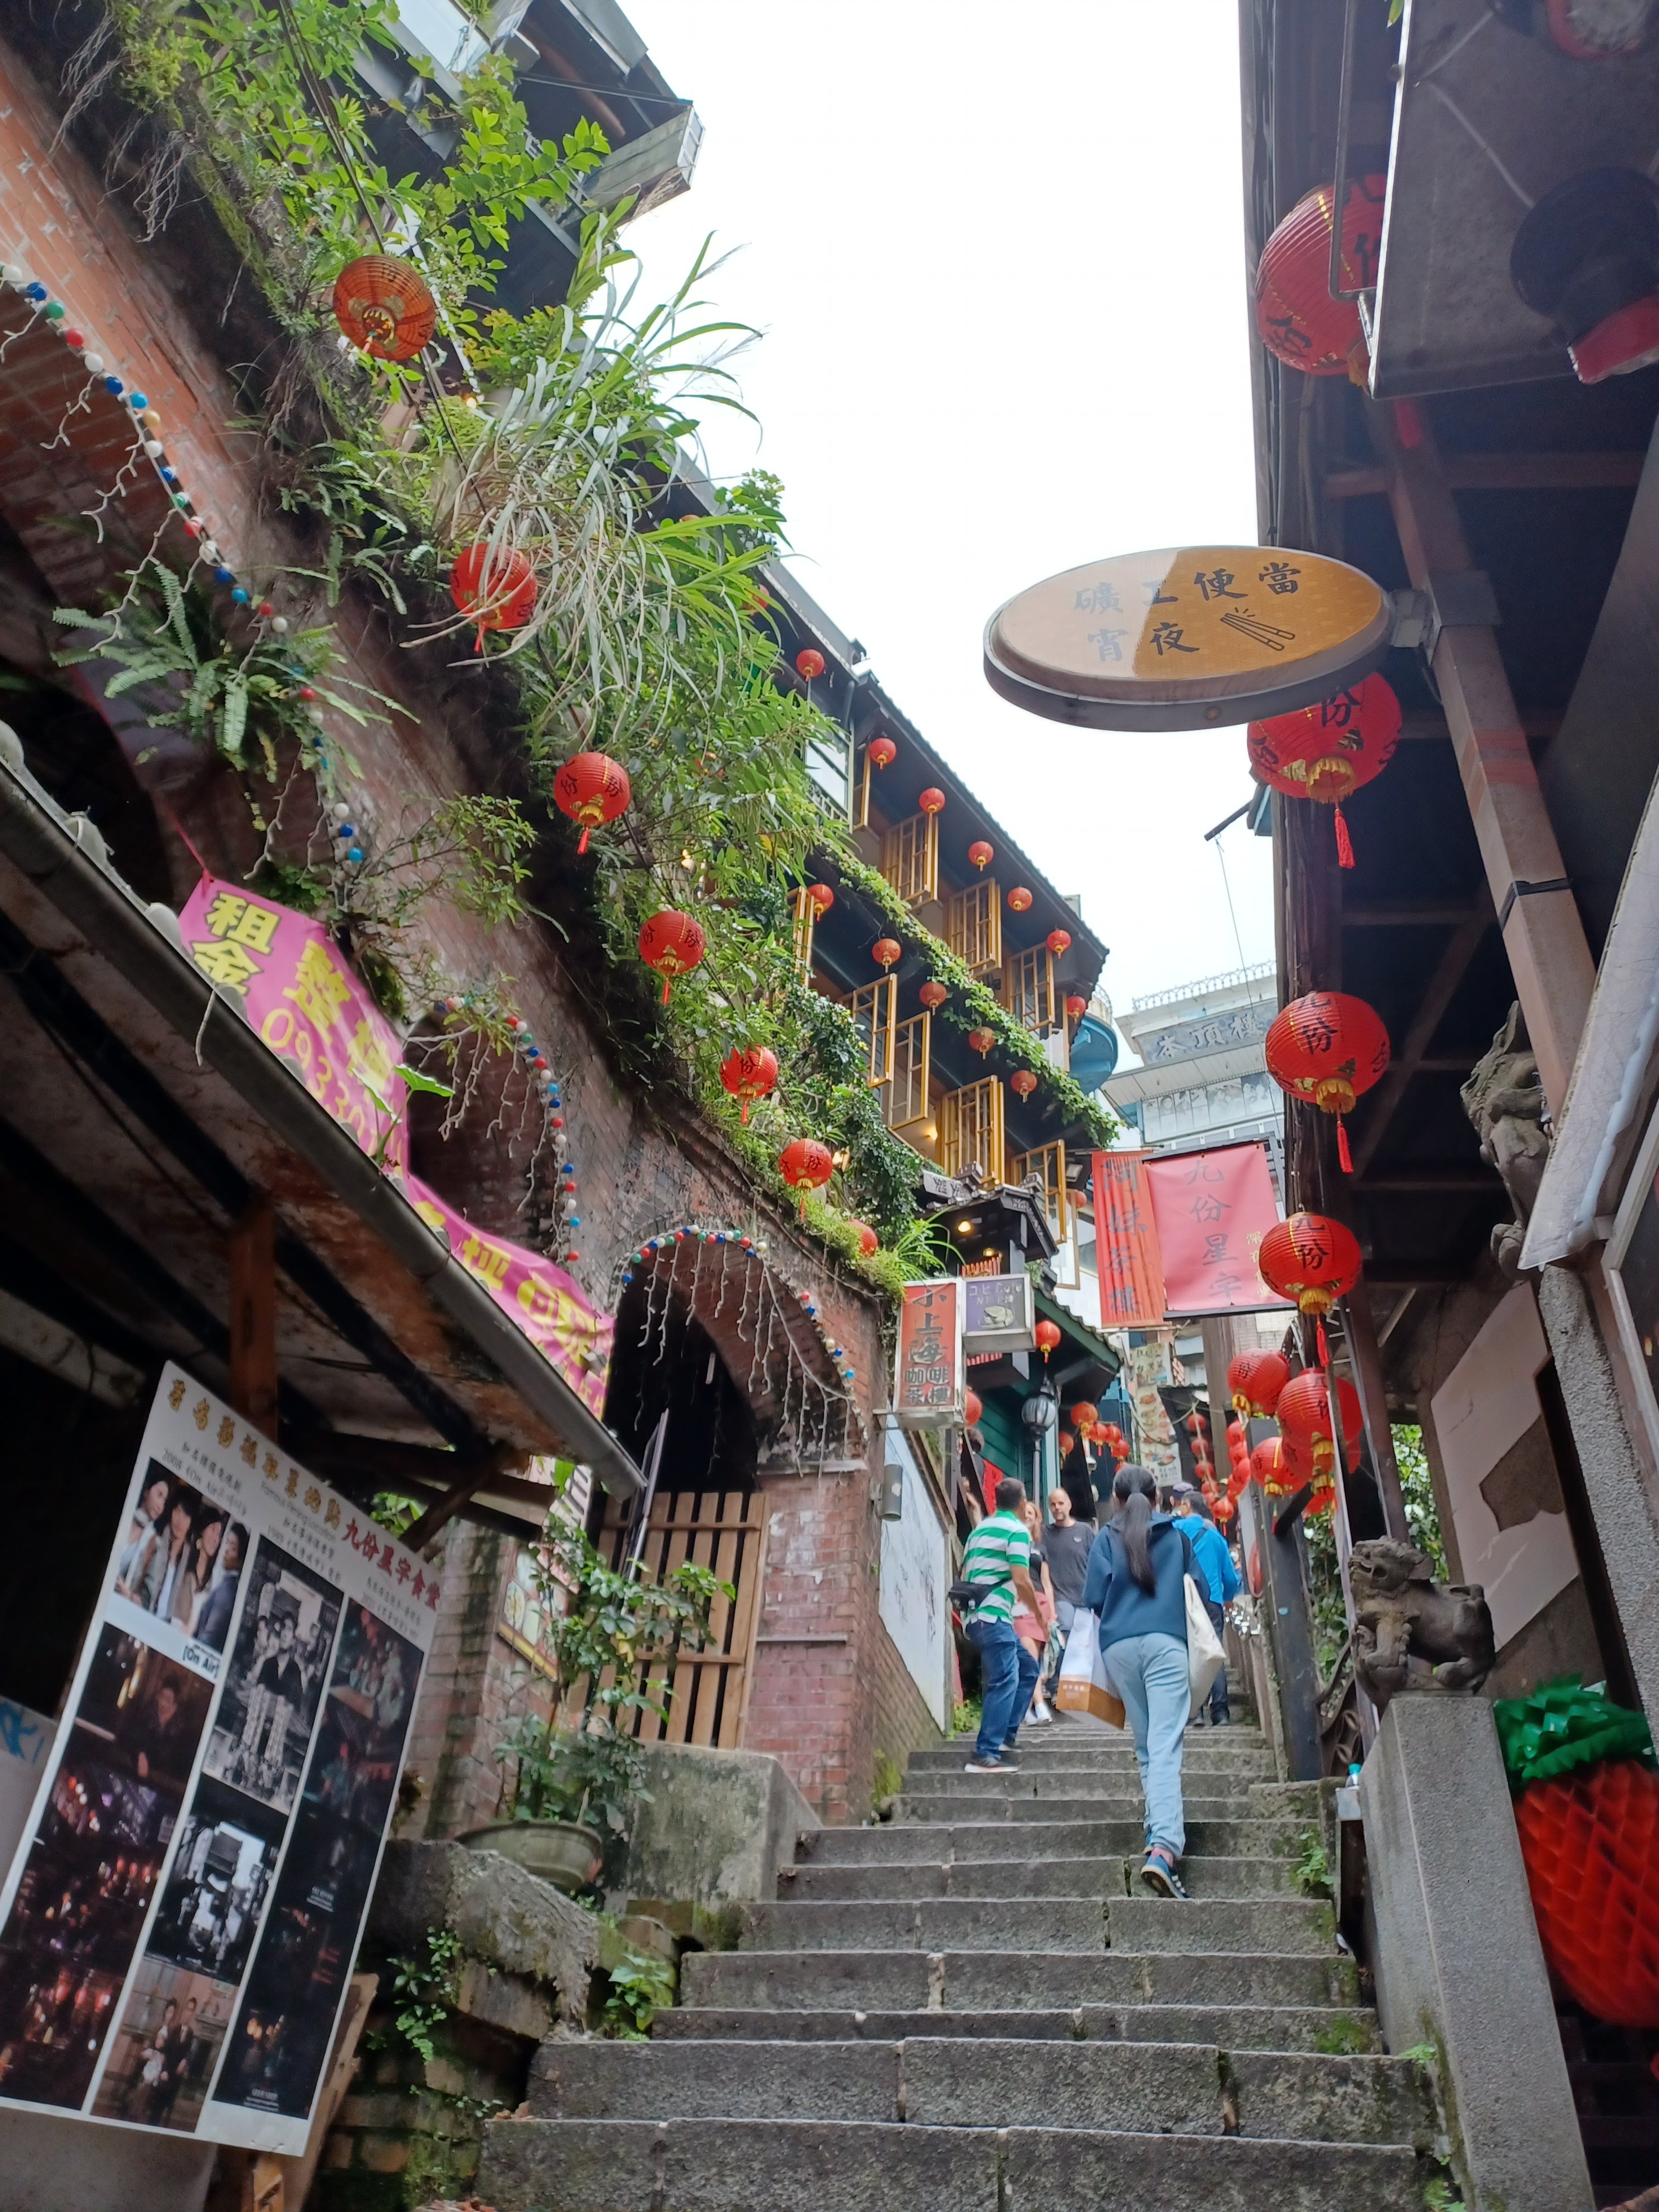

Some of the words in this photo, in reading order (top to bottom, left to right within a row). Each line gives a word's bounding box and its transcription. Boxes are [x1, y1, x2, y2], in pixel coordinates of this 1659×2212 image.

[1074, 562, 1301, 615] 礦工便當
[1087, 622, 1200, 662] 宵夜
[1183, 1160, 1243, 1305] 九份星宇
[1295, 1218, 1329, 1270] 九份
[908, 1288, 949, 1364] 小上海
[905, 1366, 950, 1385] 咖啡
[905, 1385, 951, 1405] 茶樓
[342, 1517, 441, 1612] 九份星宇食堂
